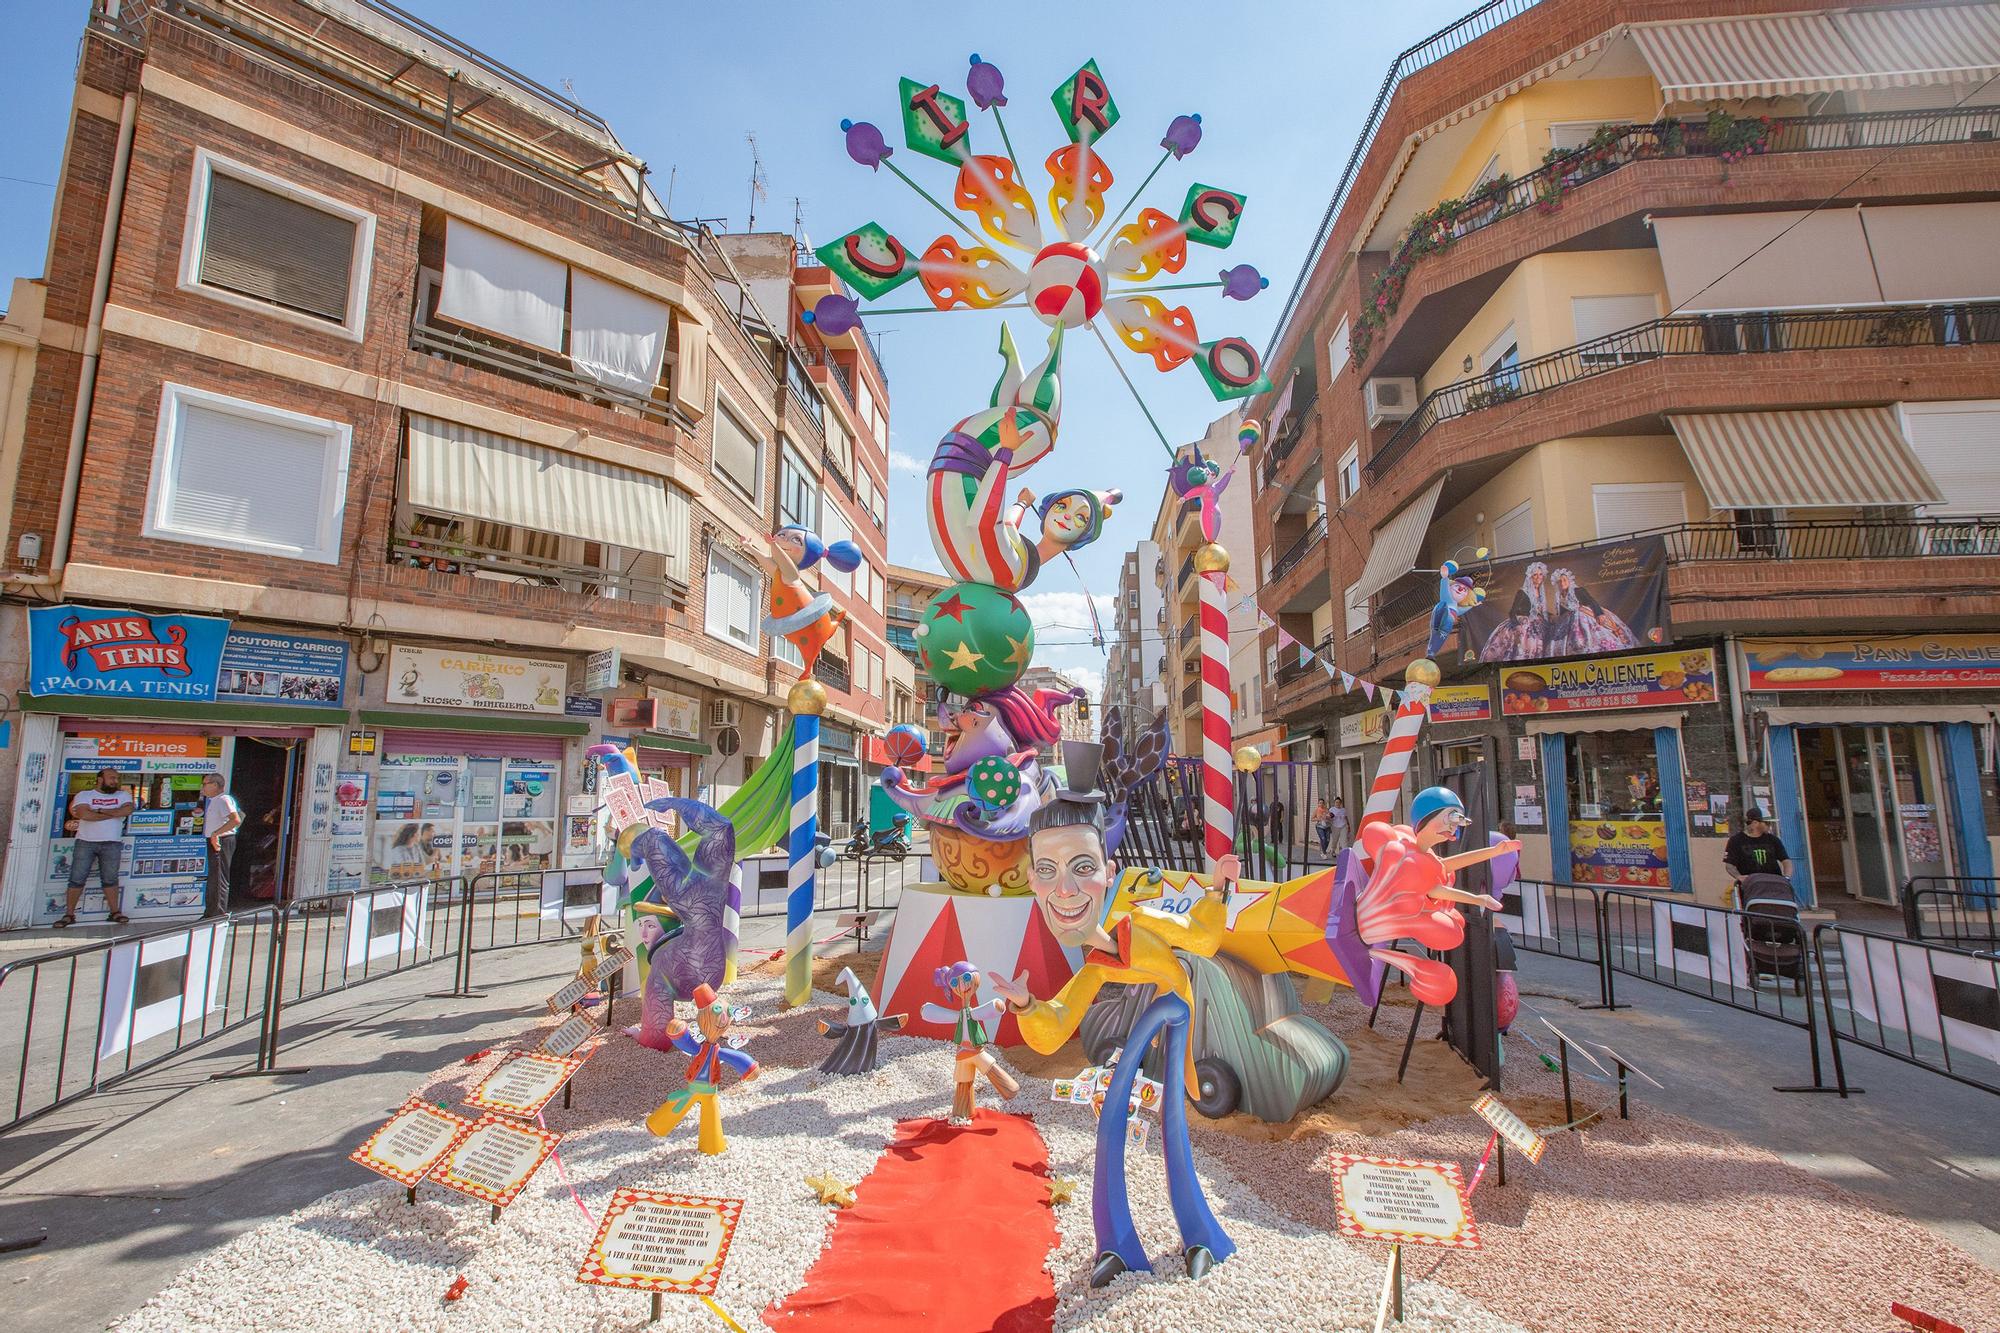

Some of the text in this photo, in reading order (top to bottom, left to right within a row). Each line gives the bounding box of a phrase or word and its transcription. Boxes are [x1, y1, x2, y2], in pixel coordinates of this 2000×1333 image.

[74, 621, 143, 646] ANIS
[226, 635, 343, 654] OCUTORIO CARRICO
[101, 648, 181, 667] TENIS
[1852, 642, 1912, 663] PAN
[440, 657, 526, 677] CARRICO
[1550, 662, 1657, 690] PAN CALIENTE
[40, 676, 210, 696] ¡PAOMA TENIS!
[423, 696, 463, 706] KIOSCO
[122, 740, 188, 753] Titanes
[146, 761, 217, 771] Lycamobile
[402, 755, 459, 766] Lycamobile
[132, 816, 169, 824] Europhil
[657, 1217, 680, 1225] CUATRO
[623, 1222, 636, 1230] CON
[678, 1229, 704, 1238] CULTURA
[631, 1243, 643, 1251] UNA
[643, 1244, 663, 1253] MISMA
[657, 1236, 675, 1244] PERO
[675, 1238, 695, 1246] TODAS
[695, 1240, 708, 1248] CON
[640, 1254, 666, 1263] ALCALDE
[630, 1263, 673, 1274] AGENDA 2030
